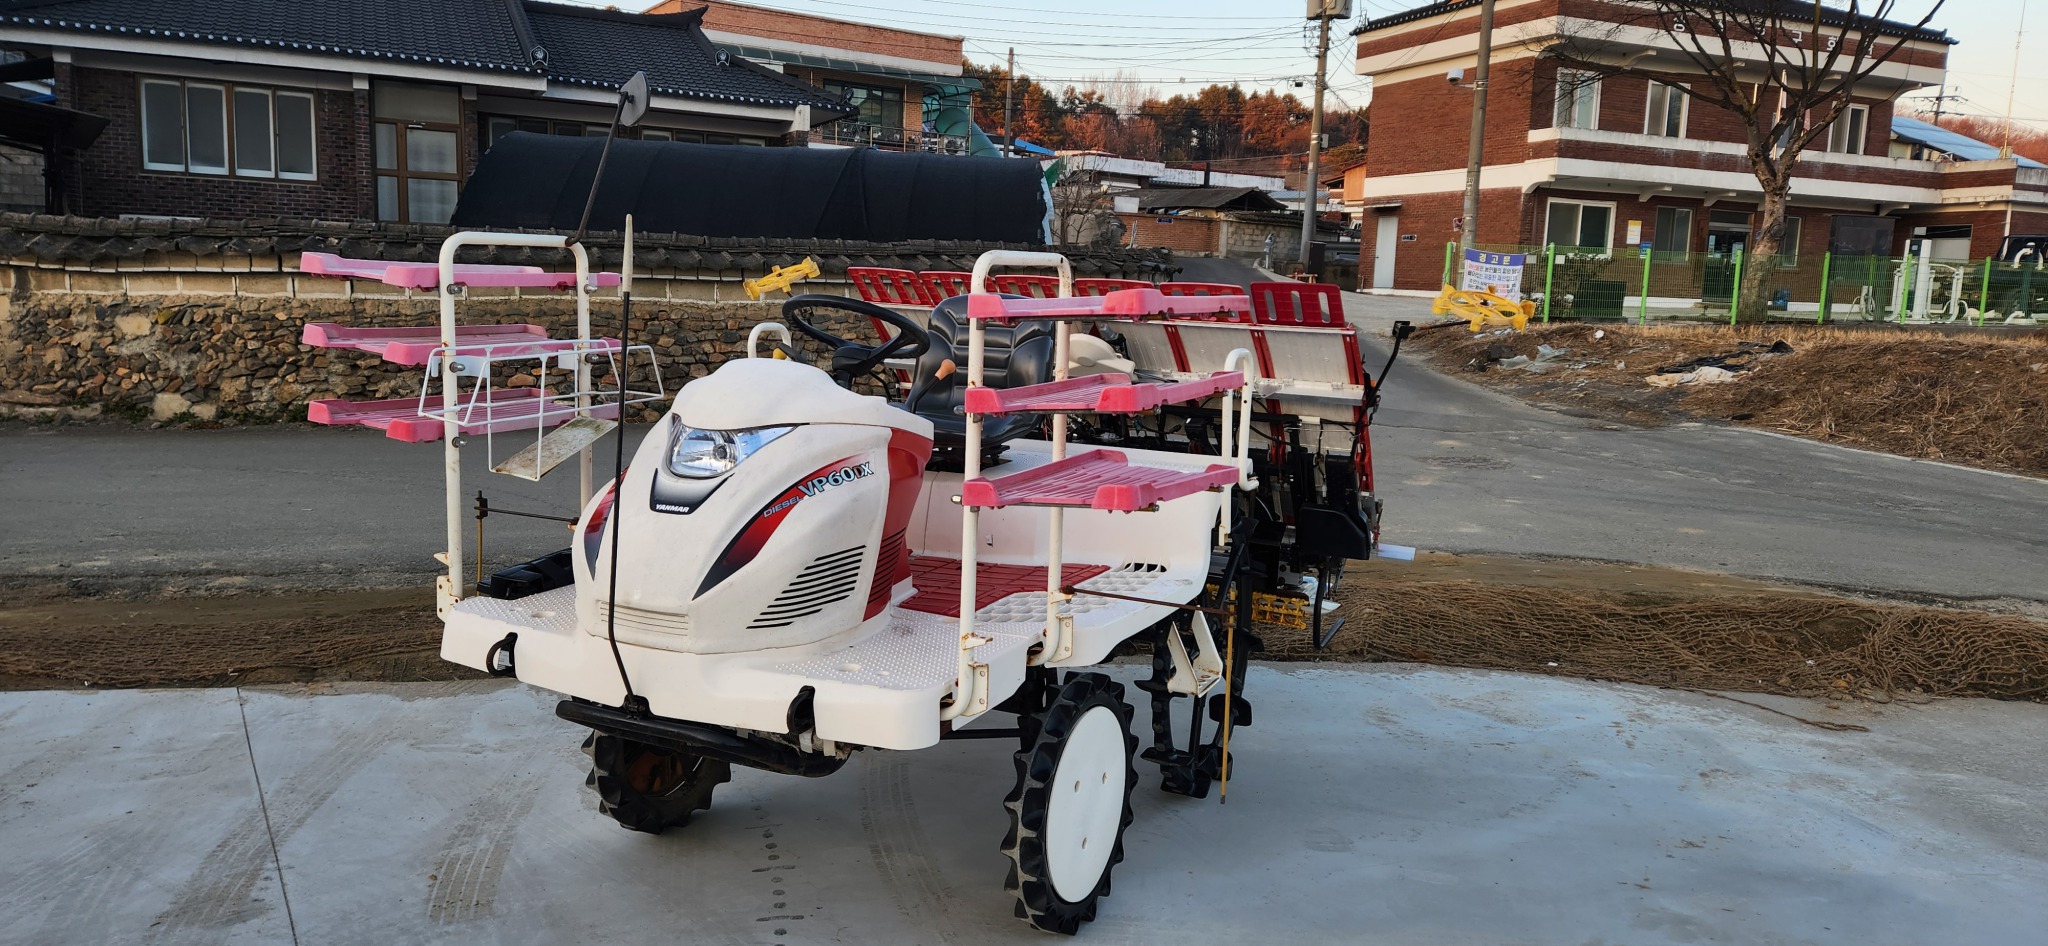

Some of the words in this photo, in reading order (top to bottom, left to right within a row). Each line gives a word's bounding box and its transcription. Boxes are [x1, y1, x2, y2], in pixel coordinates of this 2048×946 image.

[1479, 253, 1511, 265] 경고문
[763, 496, 804, 518] DIESEL
[798, 462, 874, 497] VP60DX
[656, 504, 690, 513] YANMAR
